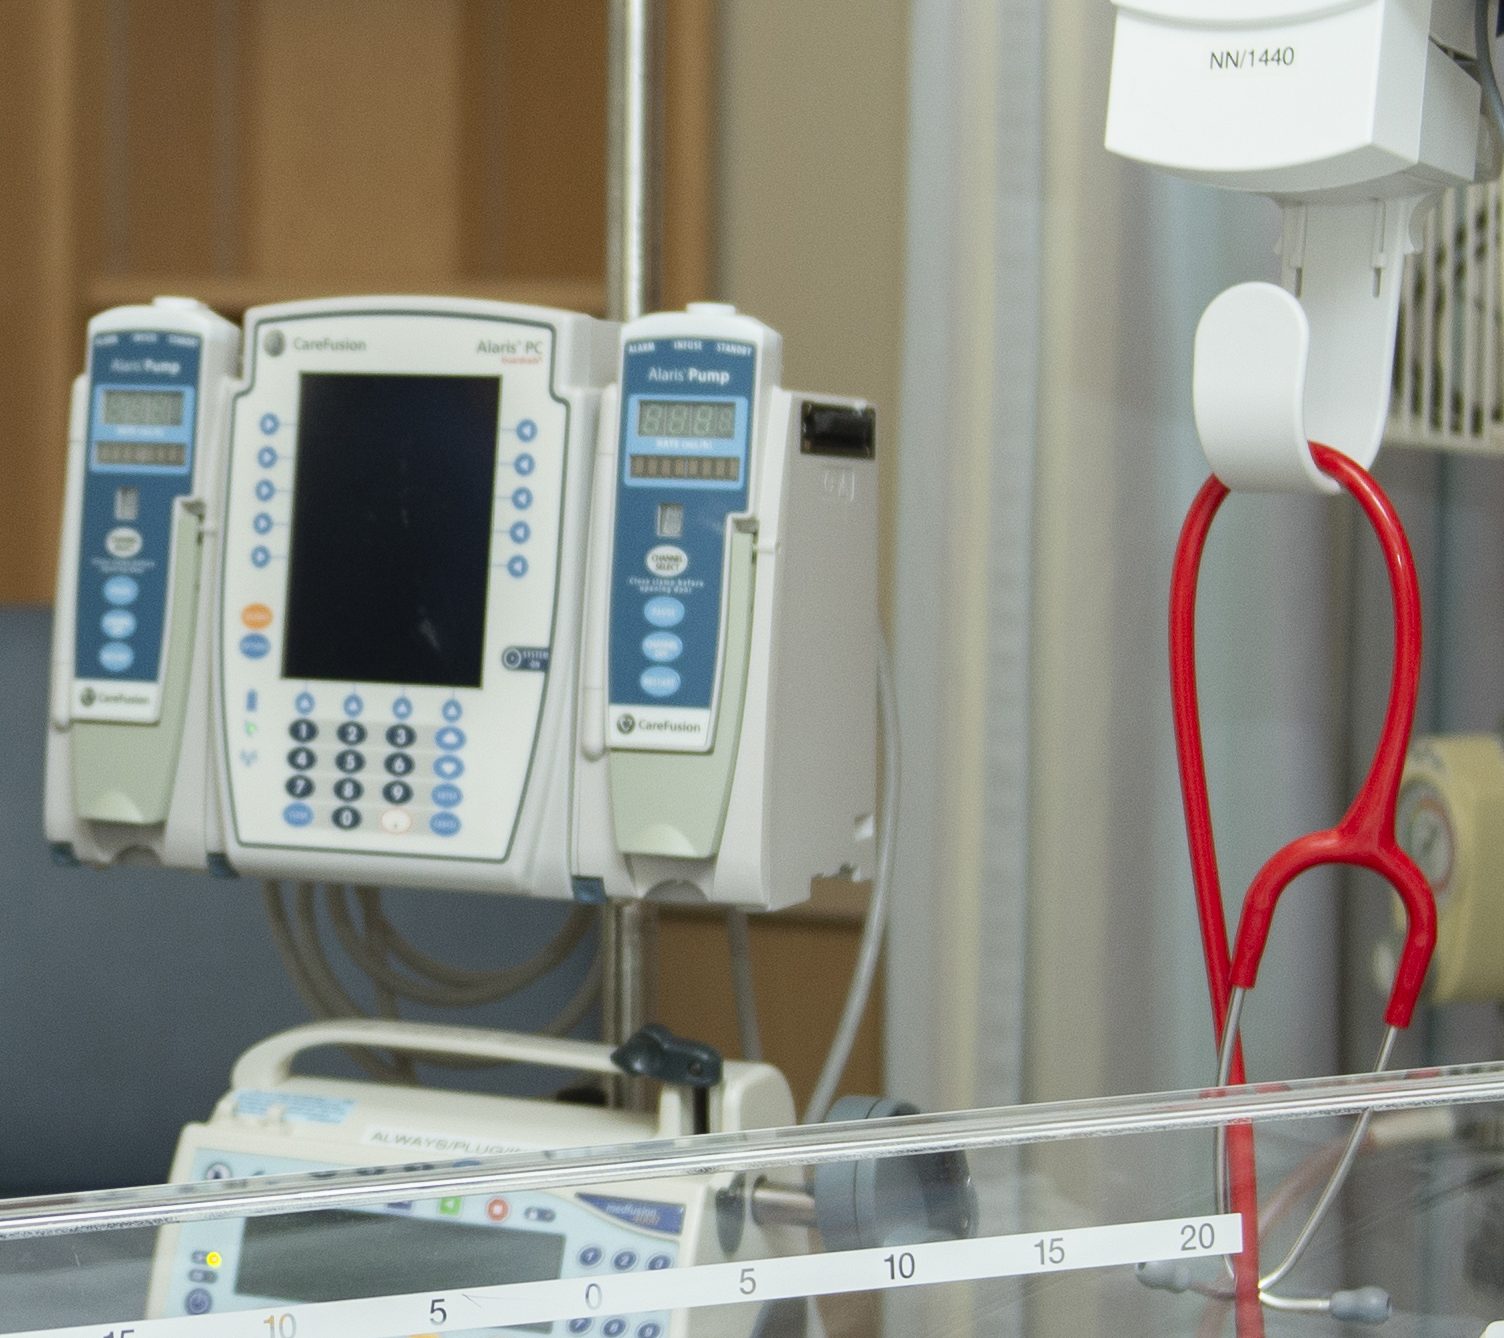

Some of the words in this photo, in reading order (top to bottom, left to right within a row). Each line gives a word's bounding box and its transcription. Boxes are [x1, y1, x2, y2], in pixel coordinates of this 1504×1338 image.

[1209, 46, 1295, 70] NN/1440
[292, 338, 367, 352] CareFusion
[524, 341, 544, 355] PC
[628, 341, 656, 354] ALARM
[673, 341, 703, 351] INFUSE
[715, 342, 752, 356] STANDBY
[143, 359, 181, 376] Pump
[688, 367, 731, 386] Pump
[651, 554, 683, 563] CHANNEL
[655, 563, 680, 571] SELECT
[298, 725, 308, 738] 1
[347, 727, 358, 740] 2
[396, 729, 406, 742] 3
[638, 719, 702, 734] CareFusion
[296, 752, 307, 765] 4
[345, 755, 355, 768] 5
[394, 758, 405, 771] 6
[295, 780, 306, 794] 7
[343, 783, 354, 796] 8
[393, 786, 403, 799] 9
[342, 811, 353, 825] 0
[606, 1202, 658, 1216] medfusion
[621, 1256, 630, 1266] 2
[428, 1298, 448, 1327] 5
[584, 1282, 603, 1311] 0
[738, 1267, 757, 1296] 5
[883, 1252, 916, 1281] 10
[1033, 1237, 1066, 1266] 15
[1179, 1222, 1215, 1252] 20
